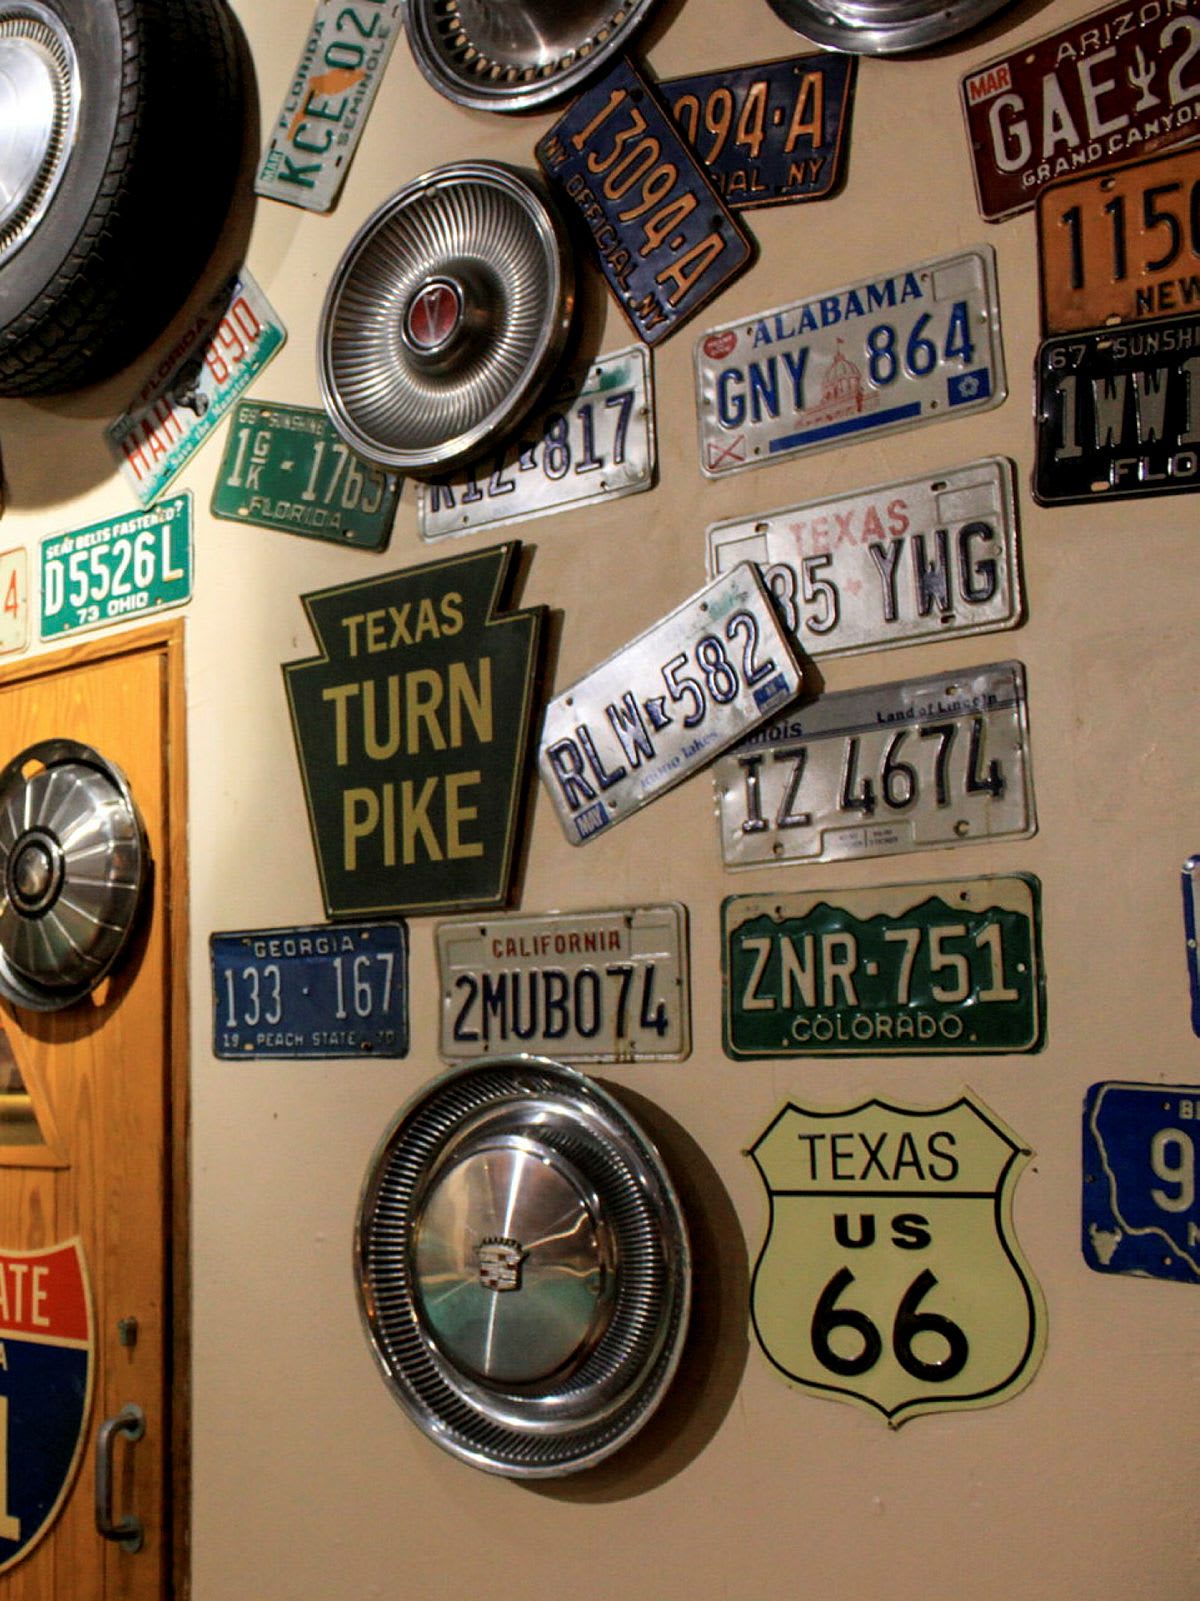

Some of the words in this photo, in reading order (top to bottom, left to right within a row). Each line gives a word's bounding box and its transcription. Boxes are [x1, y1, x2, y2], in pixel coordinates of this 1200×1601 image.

[277, 89, 348, 189] KCE
[323, 0, 388, 70] 02
[279, 21, 325, 129] FLORIDA
[336, 24, 391, 147] SEMINOLE
[969, 67, 1011, 101] MAR
[988, 45, 1130, 172] GAE
[787, 158, 826, 187] NY
[1022, 142, 1103, 187] GRAND
[566, 174, 631, 292] OFFICIAL
[202, 296, 262, 386] 890
[752, 272, 924, 349] ALABAMA
[717, 347, 809, 430] GNY
[866, 301, 975, 387] 864
[1050, 345, 1086, 369] 67
[543, 391, 635, 481] 817
[46, 538, 74, 560] SEAT
[75, 526, 111, 550] BELTS
[249, 496, 342, 528] FLORIDA
[789, 499, 911, 559] TEXAS
[76, 605, 100, 625] 73
[107, 592, 149, 616] OHIO
[868, 521, 998, 624] YWG
[341, 591, 465, 657] TEXAS
[321, 657, 494, 767] TURN
[546, 690, 656, 812] RLW
[660, 610, 777, 728] 582
[876, 706, 915, 724] Land
[836, 716, 1004, 817] 4674
[342, 770, 484, 871] PIKE
[254, 936, 354, 958] GEORGIA
[492, 930, 621, 958] CALIFORNIA
[225, 964, 282, 1028] 133
[333, 952, 395, 1020] 167
[453, 963, 669, 1042] 2MUB074
[791, 1014, 964, 1042] COLORADO
[223, 1033, 240, 1048] 19
[256, 1032, 304, 1046] PEACH
[312, 1031, 356, 1046] STATE
[798, 1131, 960, 1182] TEXAS
[834, 1213, 933, 1250] US
[811, 1265, 970, 1383] 66
